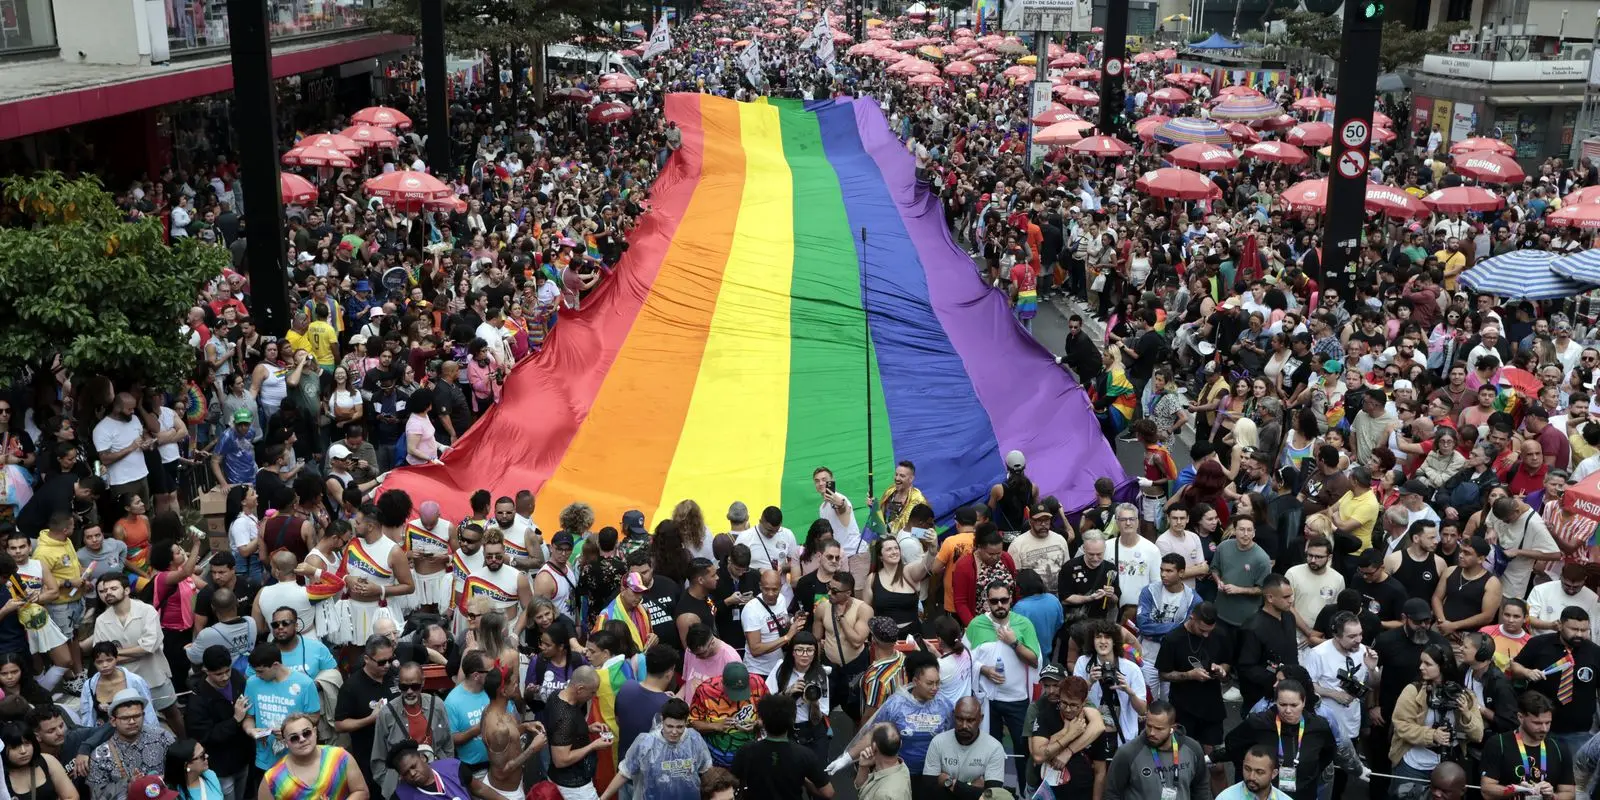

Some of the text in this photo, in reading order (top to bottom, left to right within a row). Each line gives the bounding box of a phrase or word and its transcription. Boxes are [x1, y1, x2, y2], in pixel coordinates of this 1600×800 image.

[1346, 124, 1365, 138] 50
[1465, 158, 1502, 174] BRAHMA
[1366, 190, 1408, 207] BRAHMA
[314, 333, 320, 350] 9
[944, 757, 959, 767] 169
[1155, 761, 1190, 773] OAKEY
